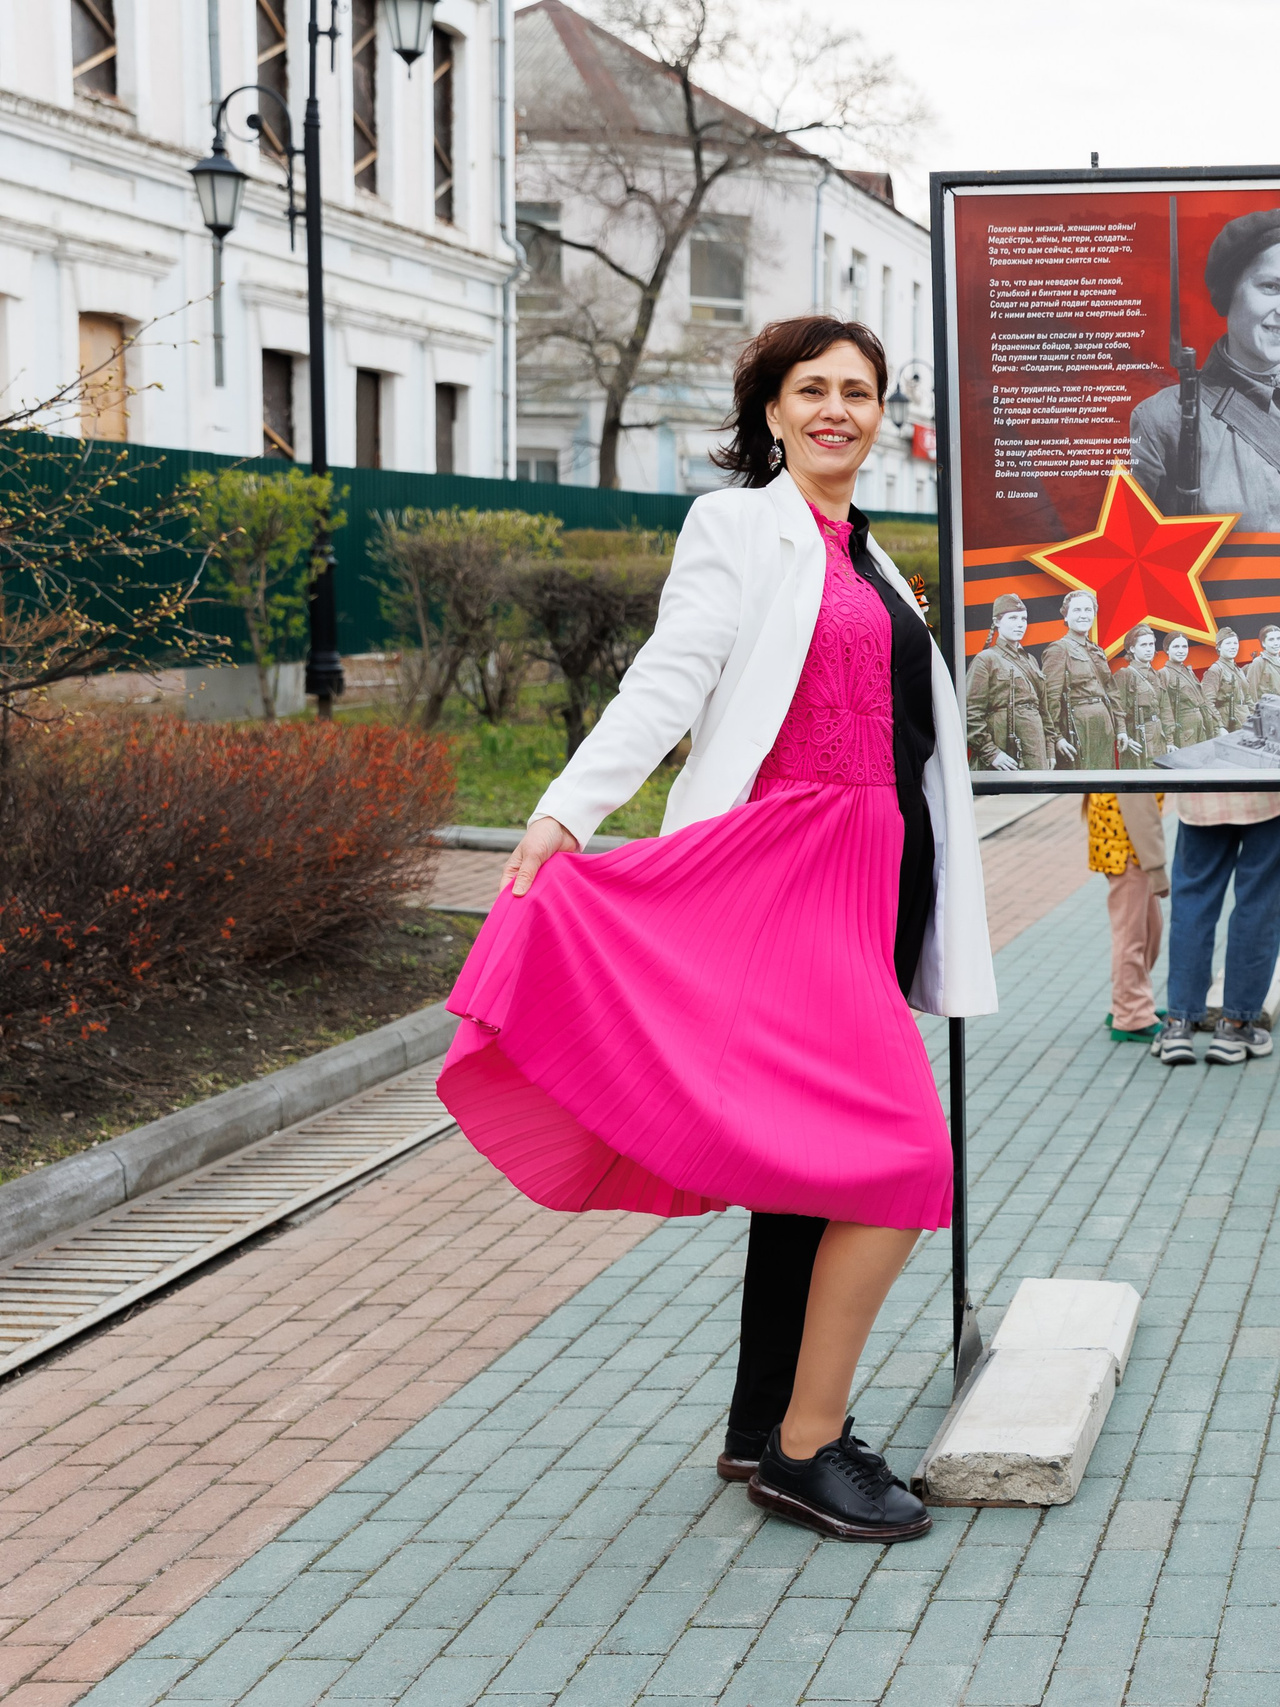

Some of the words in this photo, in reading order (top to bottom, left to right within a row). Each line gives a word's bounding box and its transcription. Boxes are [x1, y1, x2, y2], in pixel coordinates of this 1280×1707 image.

[987, 224, 1016, 233] Поклон
[1034, 224, 1065, 232] низкий,
[1067, 224, 1106, 232] женщины
[1107, 222, 1136, 231] войны!
[988, 235, 1034, 245] Медсёстры,
[1035, 235, 1059, 243] жёны,
[1061, 236, 1092, 244] матери,
[1093, 234, 1133, 242] солдаты...
[988, 246, 998, 254] За
[1044, 245, 1073, 254] сейчас,
[1096, 245, 1132, 253] когда-то,
[989, 257, 1033, 267] Тревожные
[989, 278, 999, 286] За
[1080, 277, 1096, 285] был
[1097, 276, 1123, 285] покой,
[989, 289, 995, 297] С
[996, 289, 1030, 299] улыбкой
[1038, 288, 1072, 296] бинтами
[1079, 289, 1116, 297] арсенале
[989, 300, 1018, 309] Солдат
[1030, 299, 1059, 309] ратный
[1060, 300, 1089, 308] подвиг
[1090, 299, 1141, 307] вдохновляли
[1085, 308, 1124, 318] смертный
[1125, 308, 1146, 316] бой...
[990, 332, 996, 340] А
[1085, 332, 1094, 340] ту
[1094, 332, 1114, 340] пору
[1114, 329, 1145, 338] жизнь?
[991, 342, 1040, 352] Израненных
[1041, 342, 1072, 350] бойцов,
[1074, 342, 1103, 350] закрыв
[1104, 340, 1130, 349] собою,
[991, 353, 1007, 362] Под
[1008, 354, 1037, 362] пулями
[1097, 351, 1113, 360] боя,
[991, 364, 1018, 373] Крича:
[1020, 363, 1064, 372] «Солдатик,
[1065, 362, 1114, 372] родненький,
[1115, 362, 1164, 371] держись!»...
[992, 385, 998, 393] В
[1000, 386, 1019, 394] тылу
[1020, 386, 1060, 394] трудились
[1082, 385, 1127, 393] по-мужски,
[992, 395, 999, 404] В
[1016, 395, 1045, 403] смены!
[1046, 395, 1057, 403] На
[1058, 394, 1084, 402] износ!
[1085, 394, 1091, 402] А
[1092, 395, 1131, 403] вечерами
[993, 406, 1003, 414] От
[1004, 407, 1031, 415] голода
[1032, 405, 1077, 414] ослабшими
[1078, 406, 1107, 415] руками
[993, 417, 1004, 425] На
[1005, 417, 1030, 426] фронт
[1060, 416, 1089, 424] тёплые
[994, 438, 1023, 446] Поклон
[1040, 437, 1071, 446] низкий,
[1112, 436, 1141, 444] войны!
[994, 448, 1004, 456] За
[1005, 450, 1026, 458] вашу
[1026, 448, 1065, 457] доблесть,
[1066, 448, 1104, 457] мужество
[1112, 448, 1132, 457] силу,
[994, 459, 1004, 467] За
[1069, 459, 1089, 467] рано
[1105, 458, 1139, 467] накрыла
[994, 469, 1019, 477] Война
[1020, 470, 1059, 478] покровом
[1060, 468, 1099, 478] скорбным
[995, 490, 1005, 498] Ю.
[1007, 490, 1038, 498] Шахова
